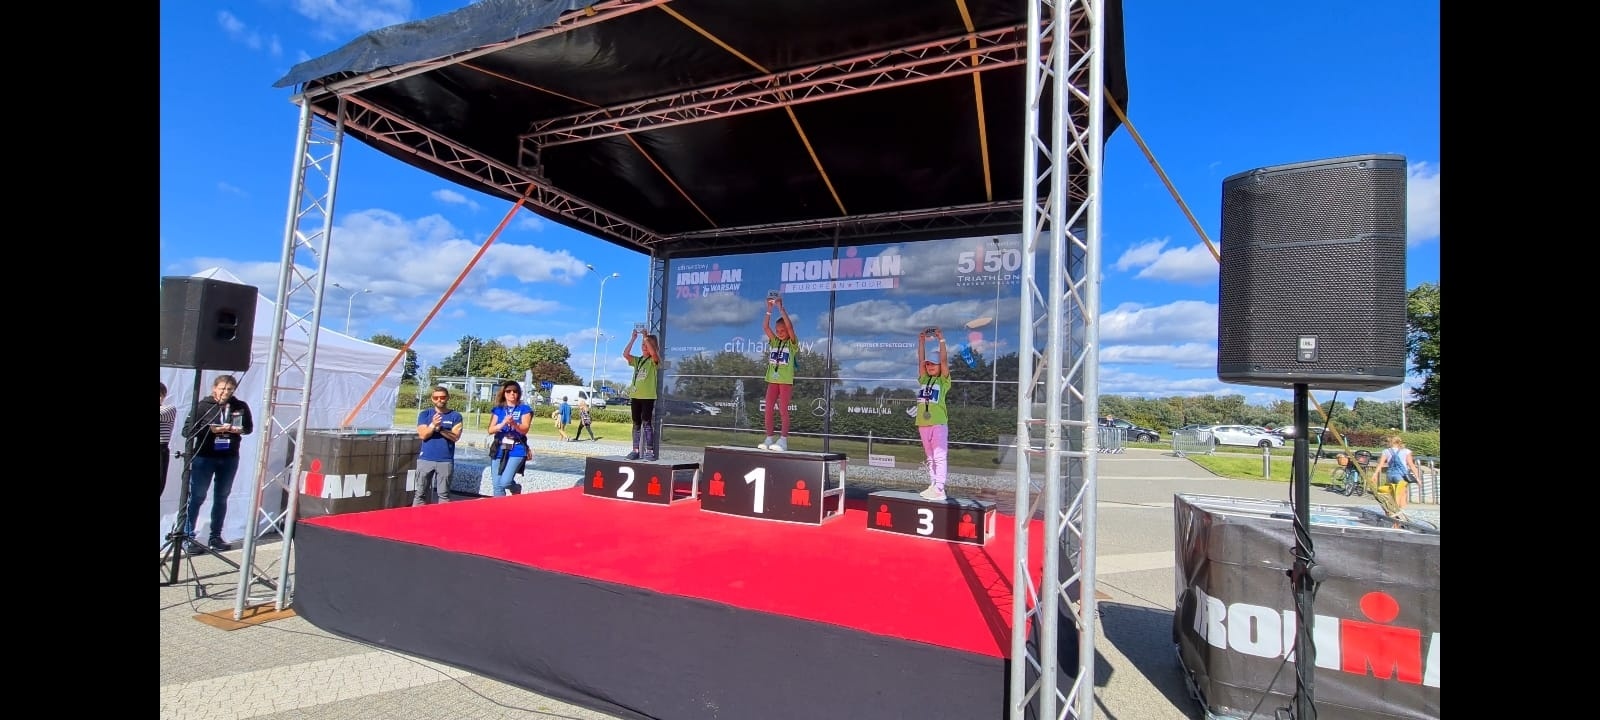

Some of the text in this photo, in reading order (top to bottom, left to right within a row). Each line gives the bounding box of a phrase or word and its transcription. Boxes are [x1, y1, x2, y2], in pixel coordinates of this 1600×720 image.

[780, 246, 901, 281] IRONMAN
[676, 263, 742, 286] IRONMAN
[956, 274, 1020, 282] TRIATHLON
[676, 285, 700, 299] 70.3
[710, 283, 742, 292] WARSAW
[724, 334, 744, 353] citi
[773, 403, 797, 411] Aott
[616, 466, 635, 499] 2
[743, 467, 766, 514] 1
[916, 508, 934, 536] 3
